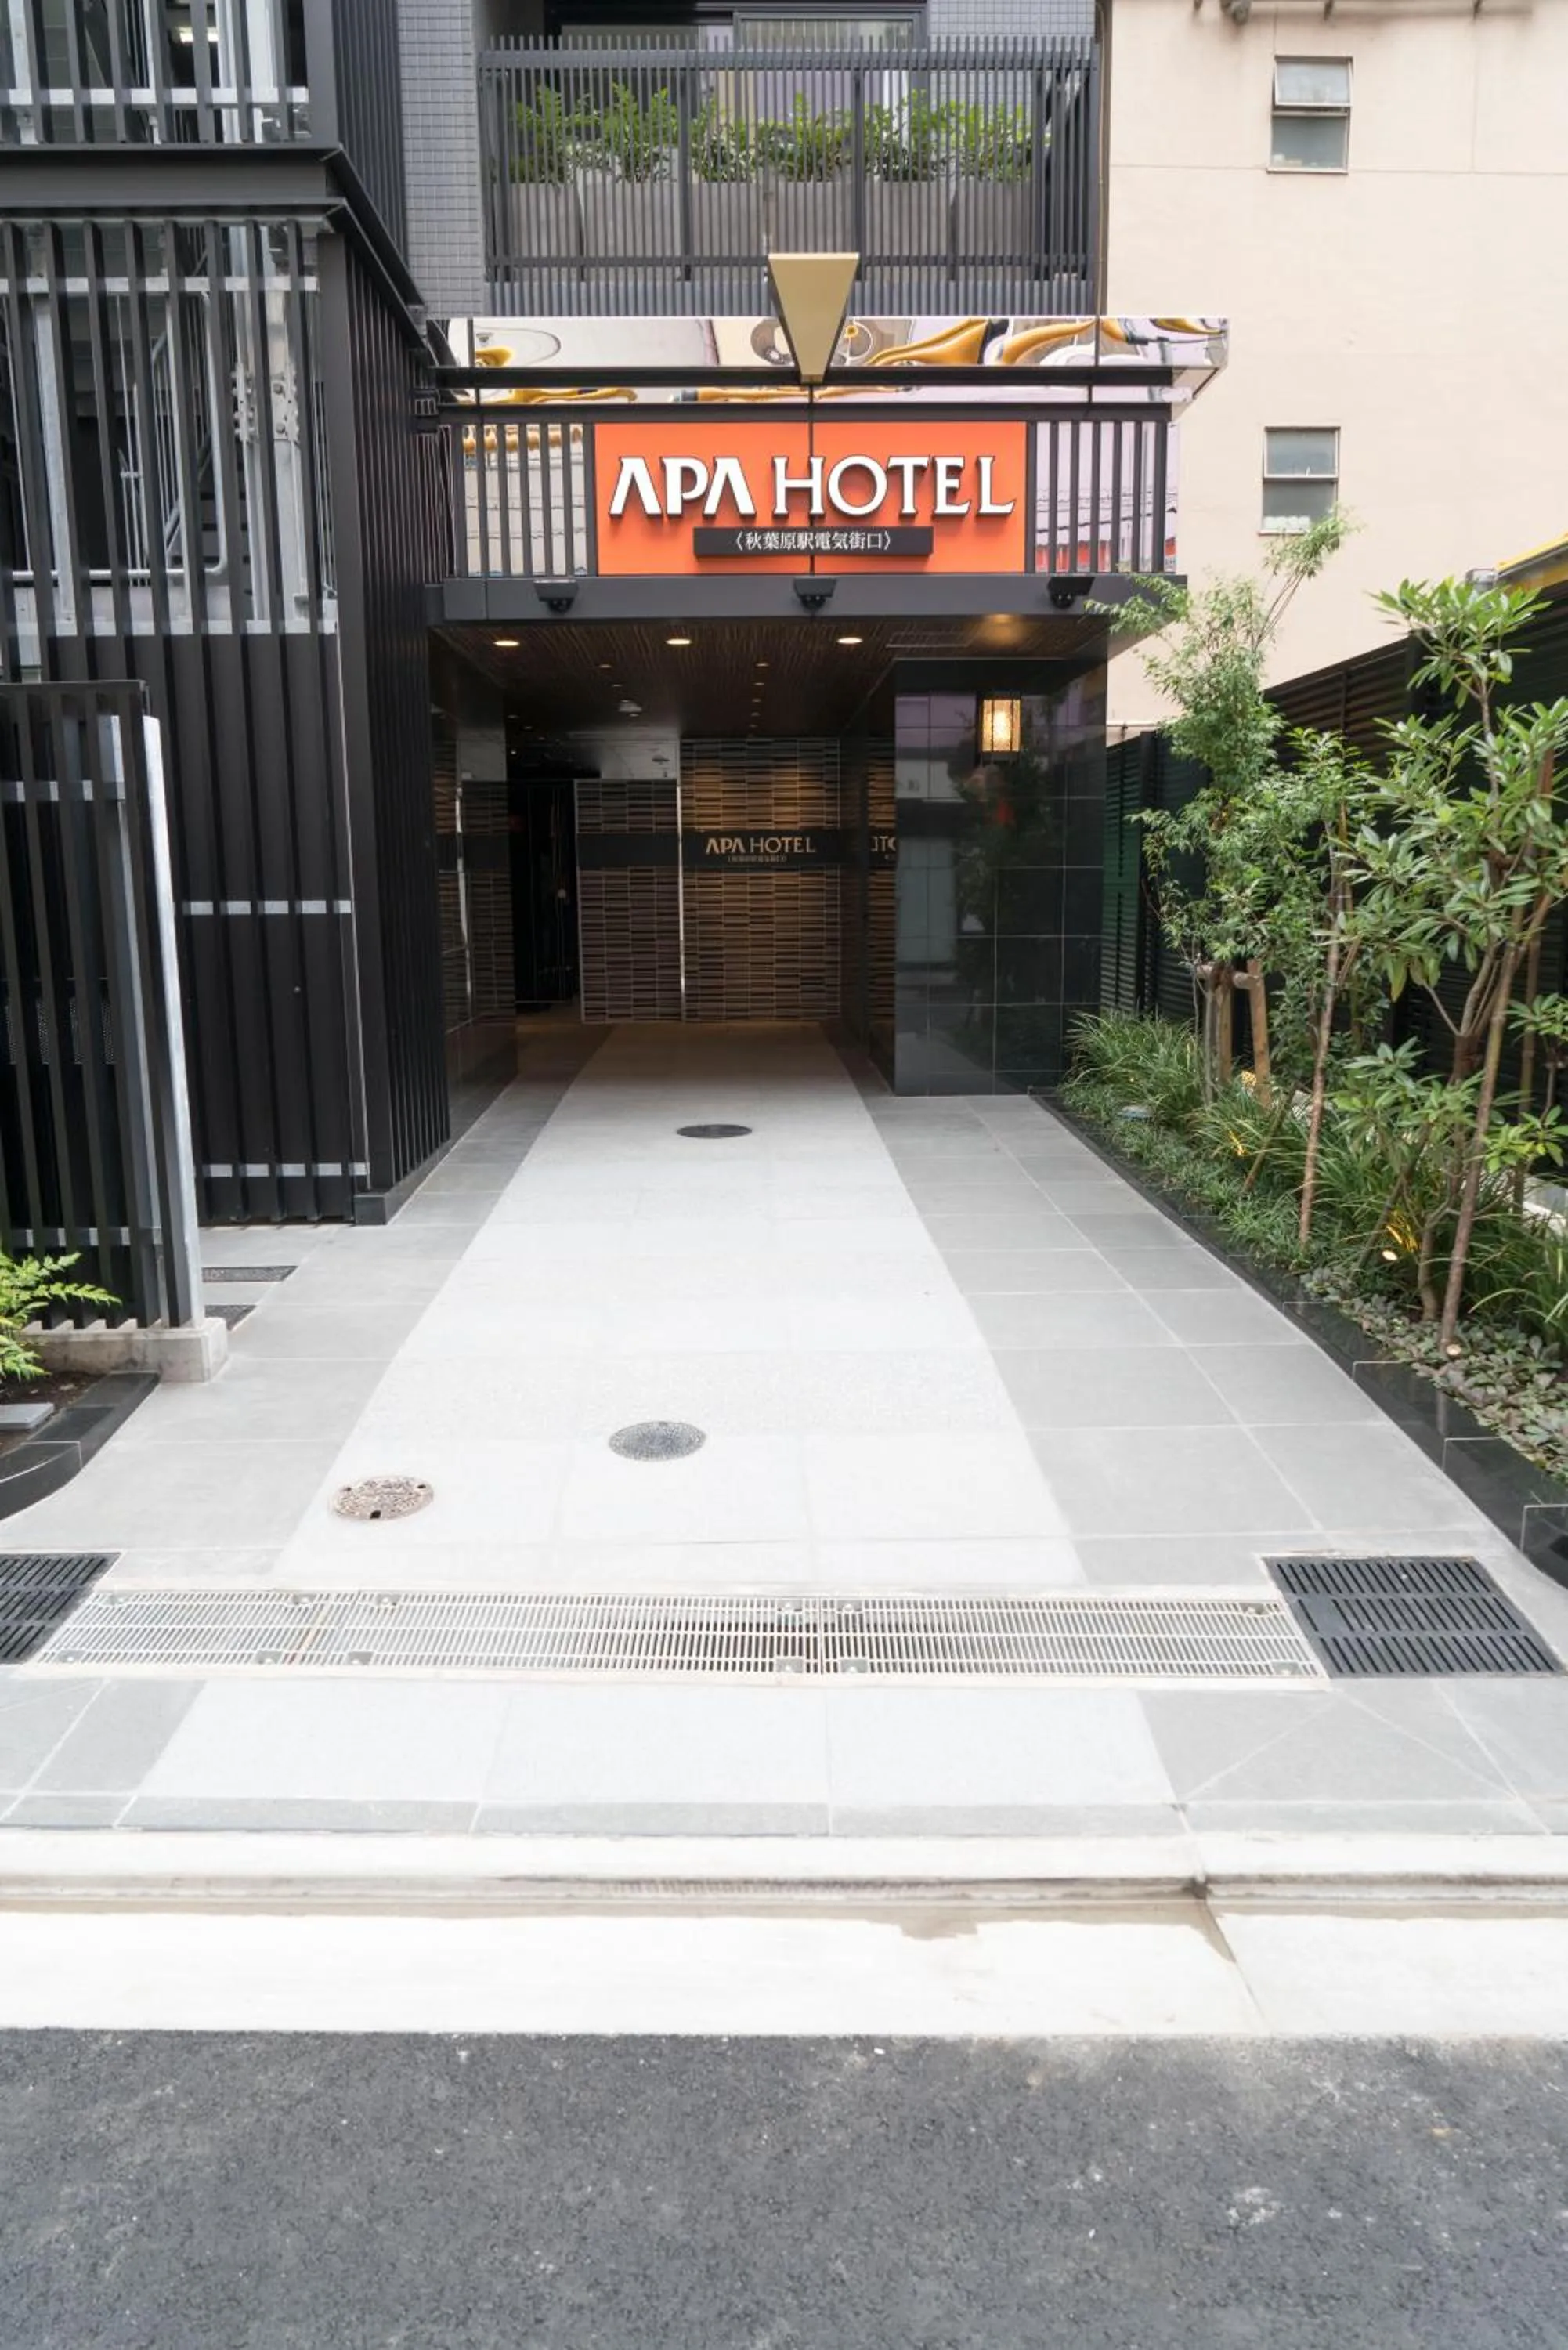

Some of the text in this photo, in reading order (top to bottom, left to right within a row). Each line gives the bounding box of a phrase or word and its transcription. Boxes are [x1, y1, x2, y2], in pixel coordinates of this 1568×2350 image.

[609, 454, 1017, 516] APA HOTEL
[706, 837, 815, 854] APA HOTEL
